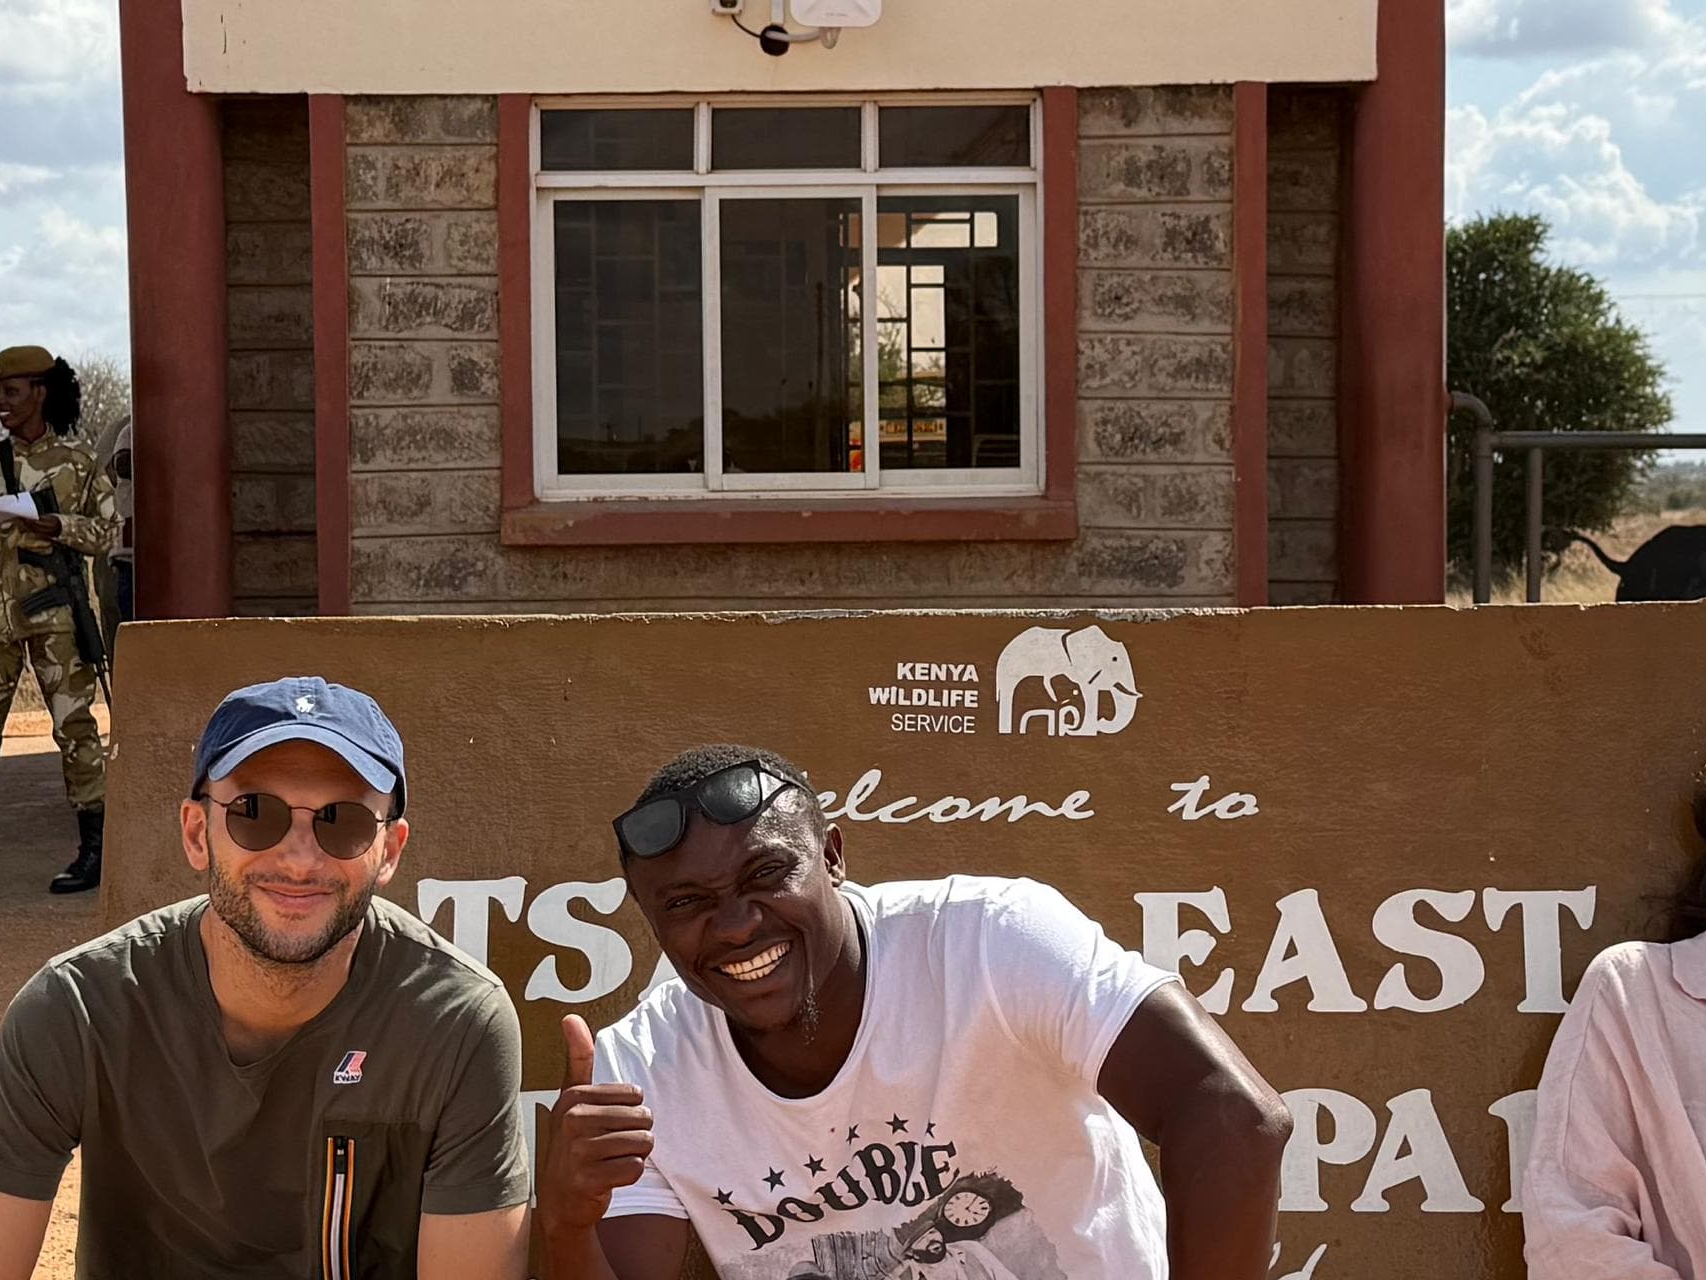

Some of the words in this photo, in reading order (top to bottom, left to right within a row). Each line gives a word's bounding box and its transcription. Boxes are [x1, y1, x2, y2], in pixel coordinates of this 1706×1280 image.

[897, 662, 979, 682] KENYA
[868, 686, 979, 708] WILDLIFE
[891, 713, 976, 734] SERVICE
[801, 769, 1096, 823] elcome
[1167, 775, 1260, 821] to
[1134, 885, 1597, 1015] EAST
[721, 1140, 961, 1251] DOUBLE
